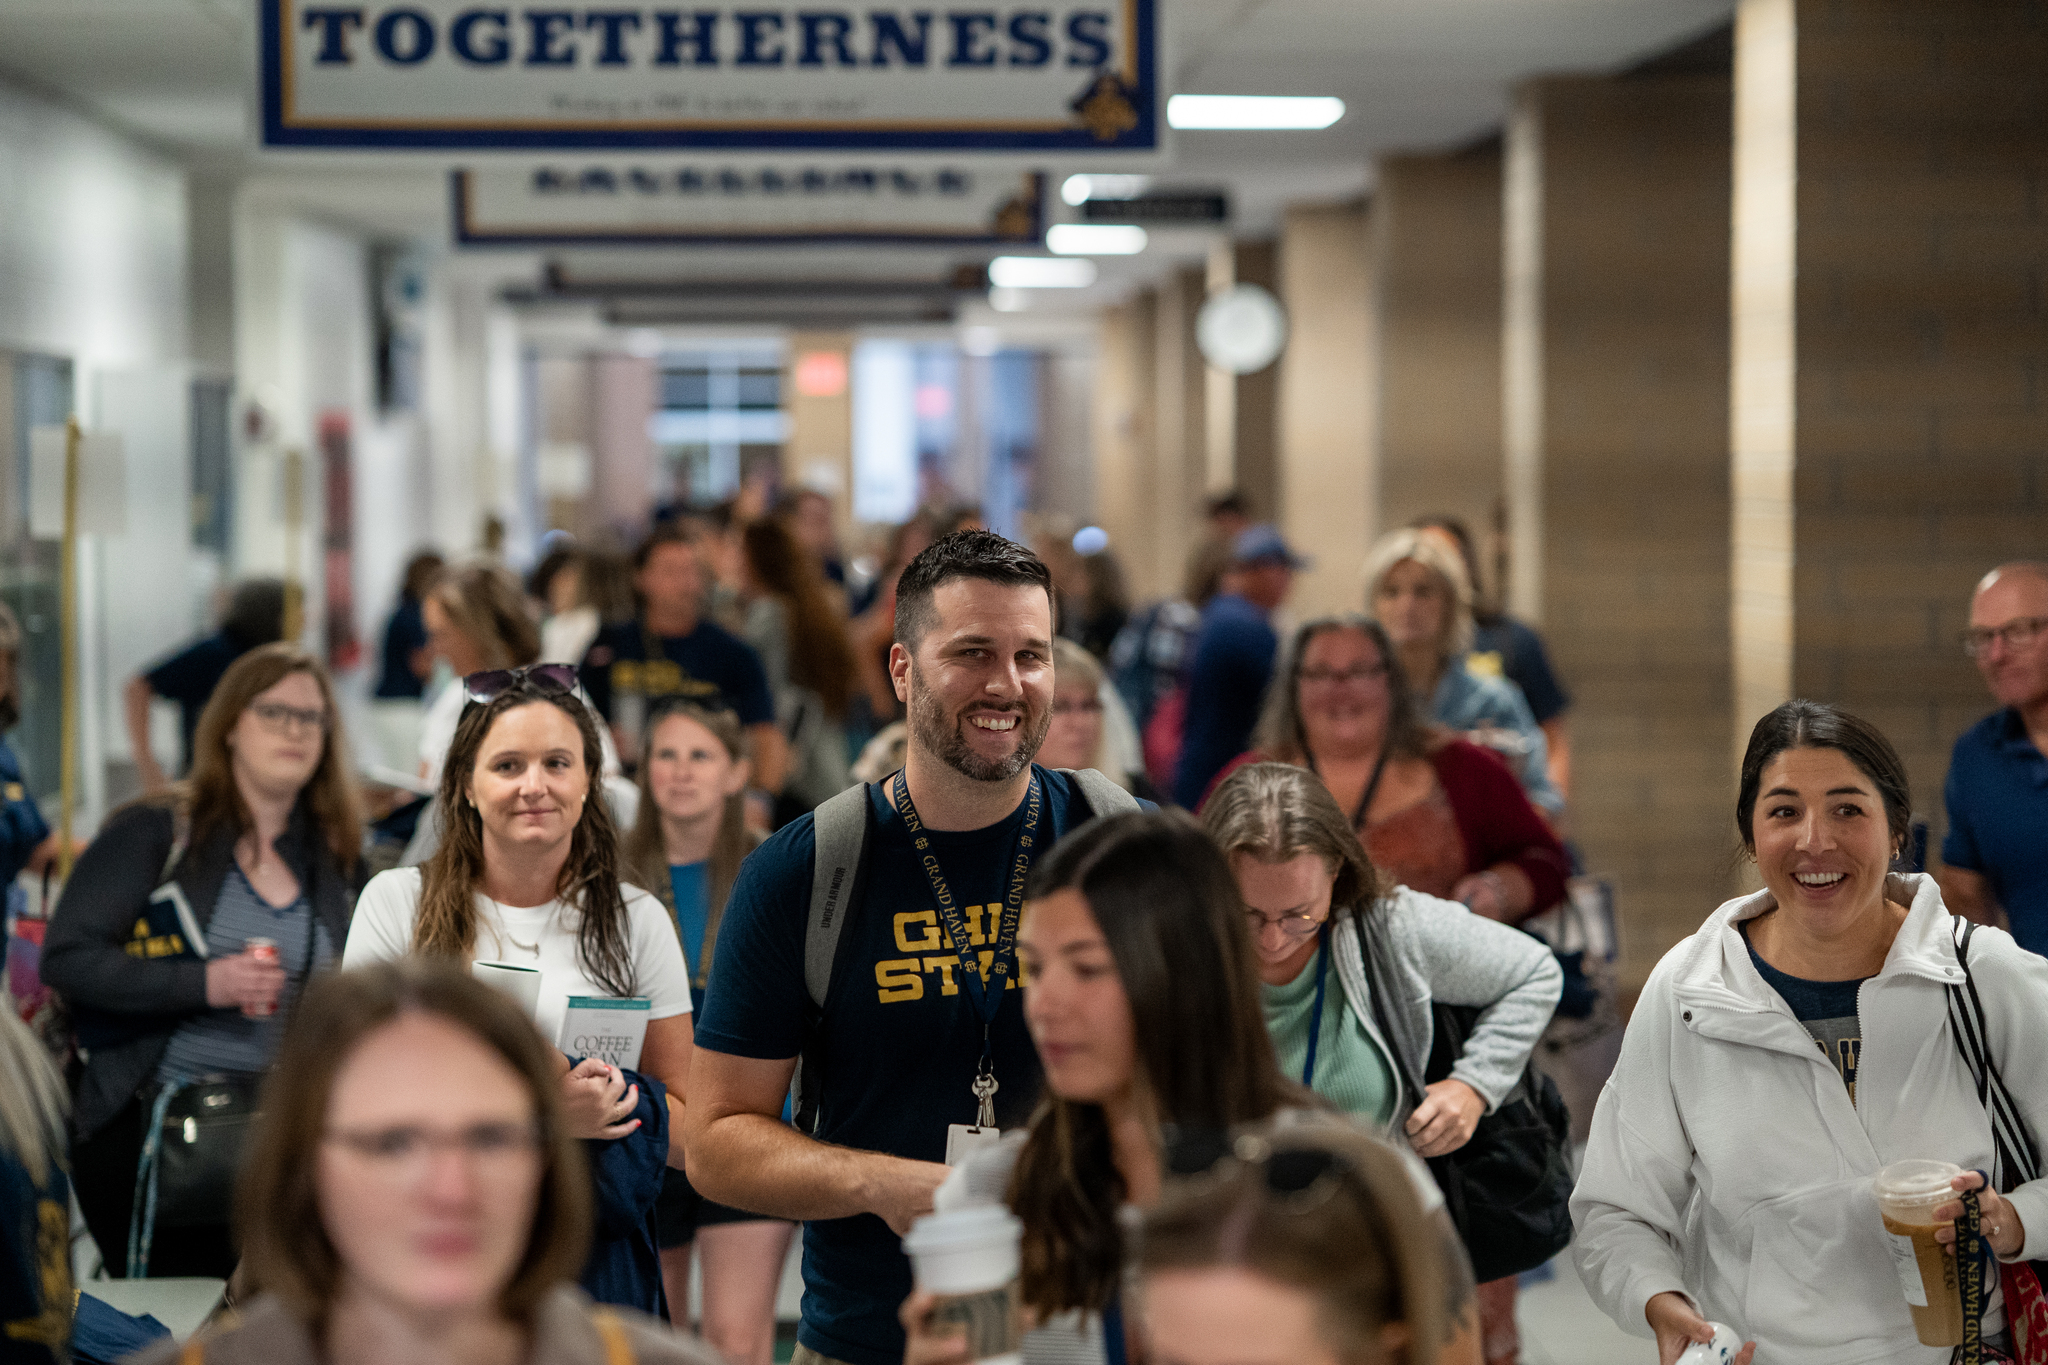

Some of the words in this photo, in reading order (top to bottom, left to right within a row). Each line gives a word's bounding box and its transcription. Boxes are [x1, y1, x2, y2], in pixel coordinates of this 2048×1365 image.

[304, 8, 1112, 68] TOGETHERNESS
[896, 787, 922, 833] HAVEN
[1025, 783, 1040, 831] HAVEN
[828, 866, 847, 901] ARMOUR
[1008, 854, 1029, 905] GRAND
[821, 900, 837, 929] UNDER
[923, 855, 952, 905] GRAND
[944, 907, 972, 955] HAVEN
[998, 907, 1019, 956] HAVEN
[573, 1034, 633, 1051] COFFEE
[1962, 1194, 1980, 1232] GRA
[1965, 1261, 1980, 1316] HAVEN
